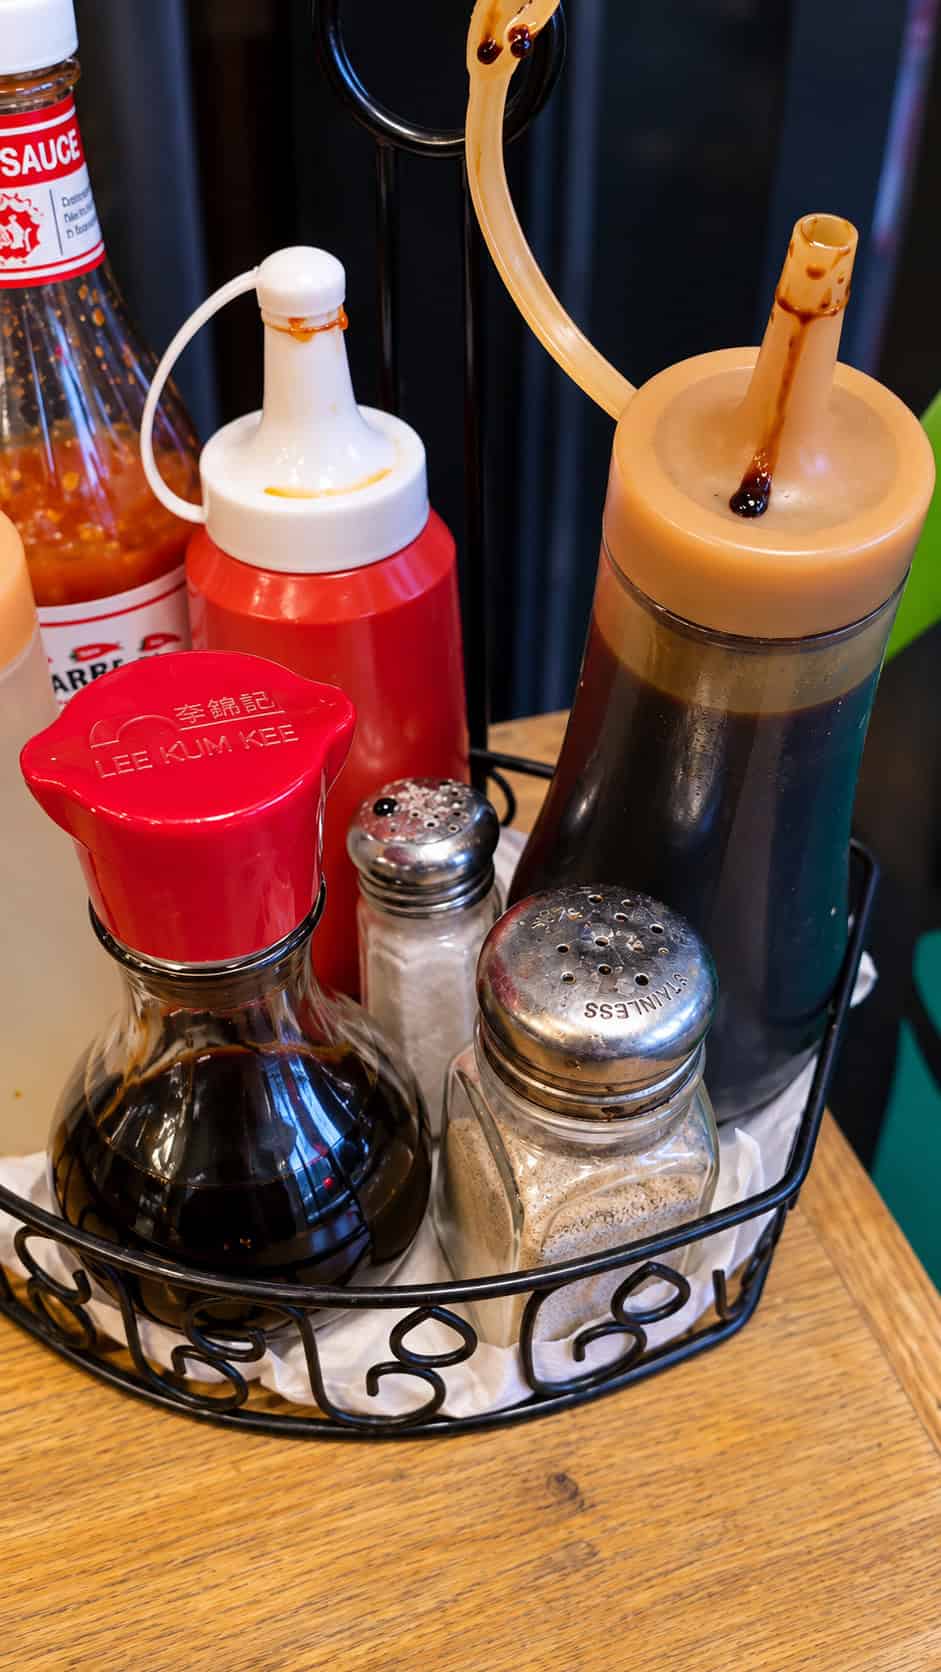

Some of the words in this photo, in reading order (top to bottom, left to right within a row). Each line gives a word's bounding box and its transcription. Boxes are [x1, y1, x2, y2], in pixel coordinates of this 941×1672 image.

[1, 129, 80, 177] SAUCE
[174, 691, 275, 723] 李錦記
[95, 750, 152, 779] LEE
[159, 735, 232, 764] KUM
[239, 724, 299, 750] KEE
[584, 973, 688, 1019] STAINLESS
